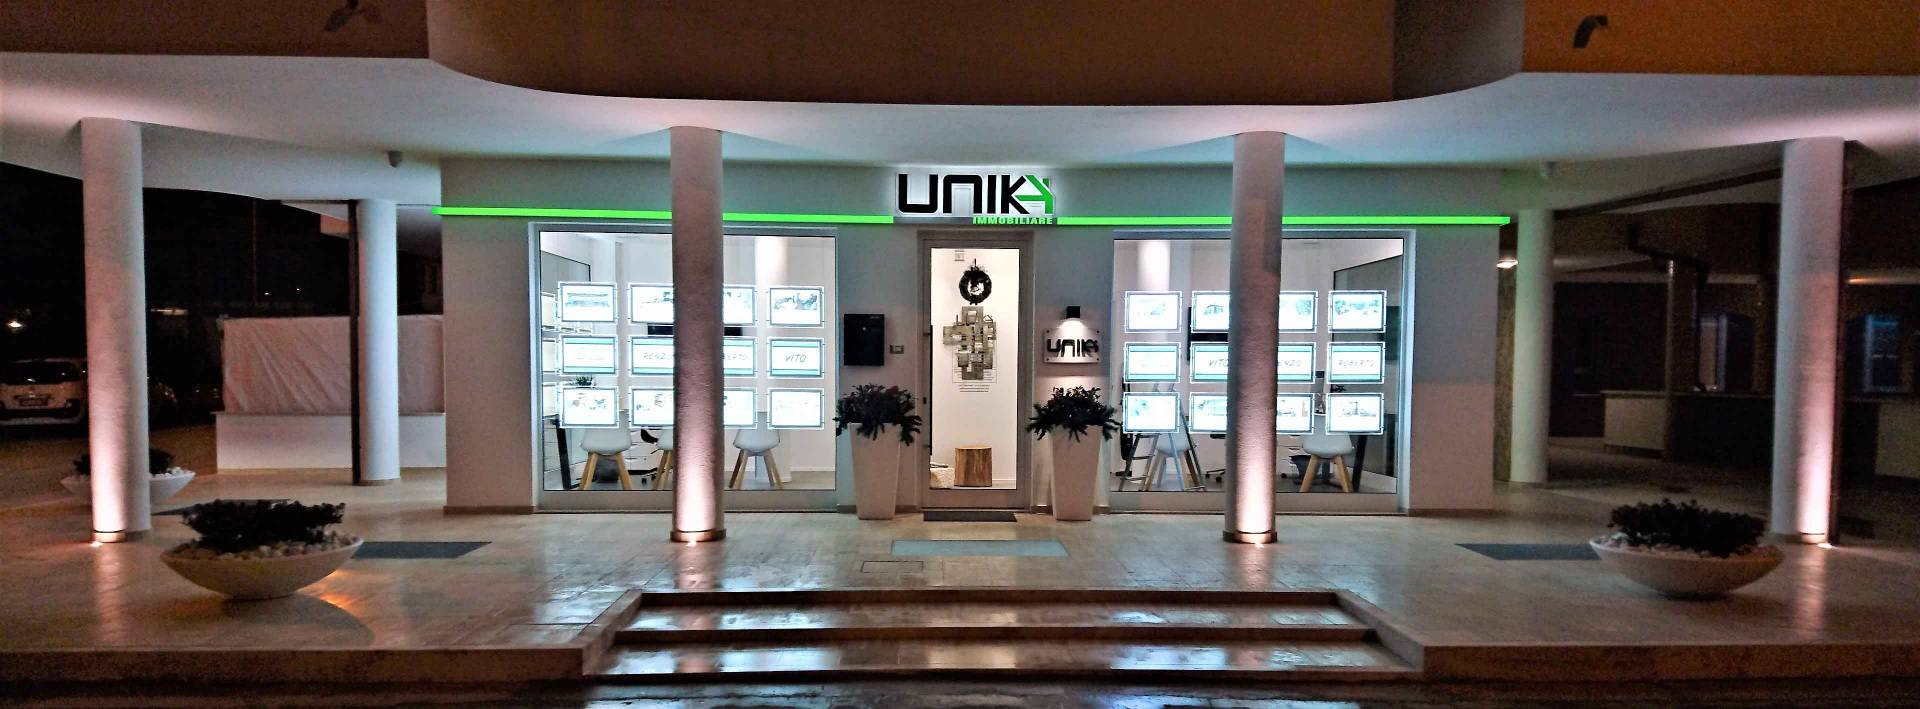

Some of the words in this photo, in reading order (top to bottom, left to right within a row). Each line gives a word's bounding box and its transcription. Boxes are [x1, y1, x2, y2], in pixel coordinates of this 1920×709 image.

[898, 174, 1054, 214] UNIKA
[972, 217, 1053, 225] IMMOBILIARE
[1047, 339, 1099, 355] UNIKA
[785, 353, 807, 362] VITO
[1277, 359, 1303, 367] ENZO
